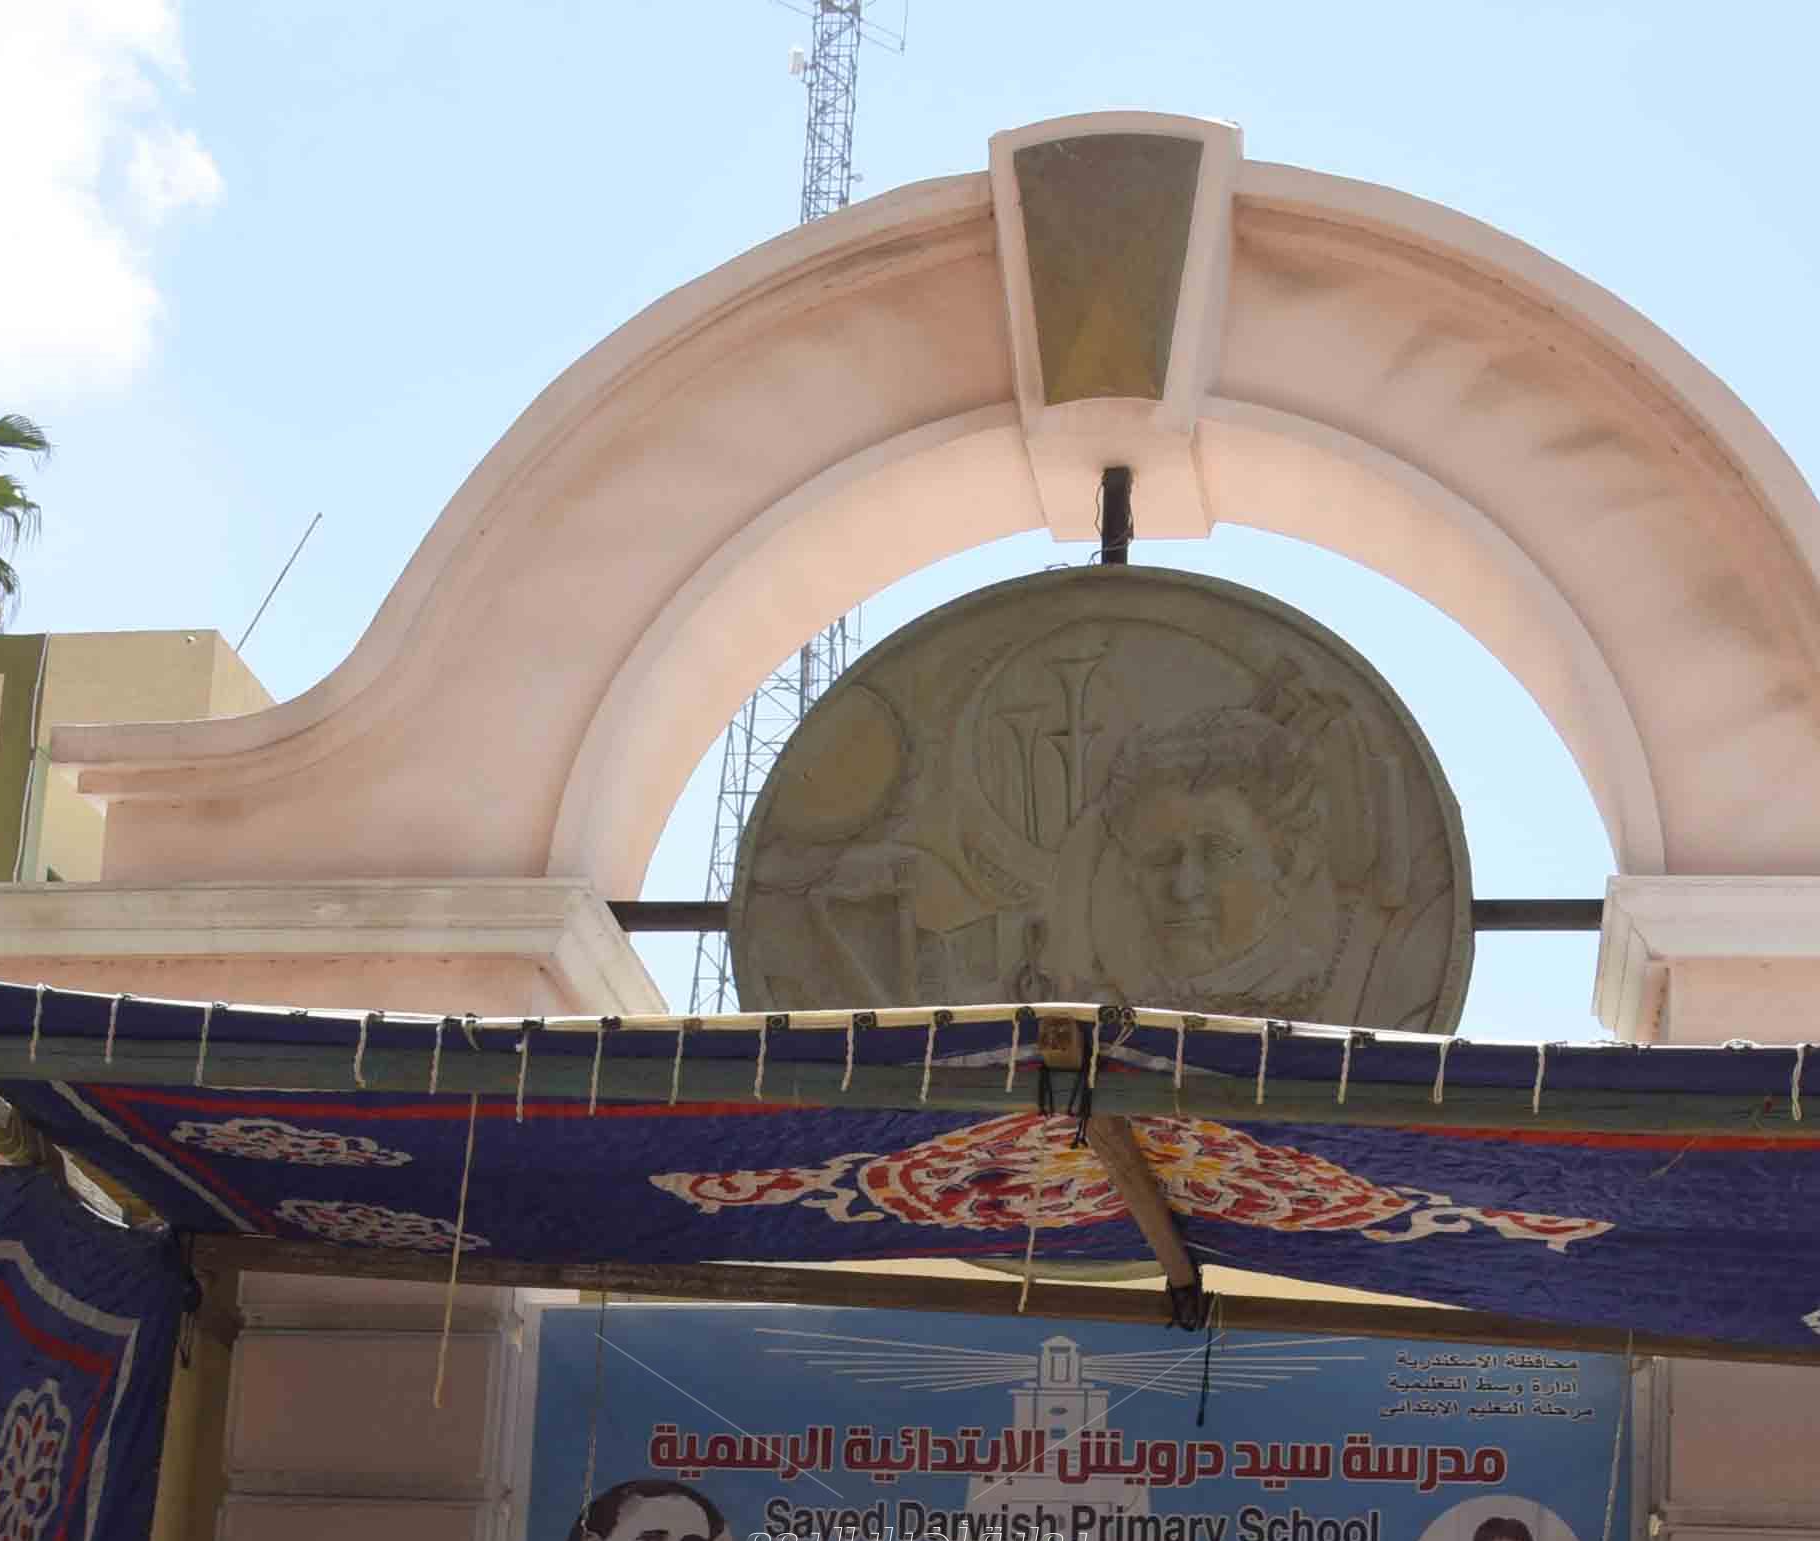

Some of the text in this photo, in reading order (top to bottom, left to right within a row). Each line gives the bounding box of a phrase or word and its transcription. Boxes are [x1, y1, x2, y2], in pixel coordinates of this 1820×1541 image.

[1504, 1353, 1579, 1370] محافظة
[1388, 1374, 1468, 1393] التعليمية
[1475, 1376, 1524, 1395] وسط
[1467, 1400, 1524, 1417] التعليم
[1532, 1400, 1595, 1421] مرحلة
[650, 1424, 1508, 1491] مدرسة سيد درويش الإبتدائية الرسمية
